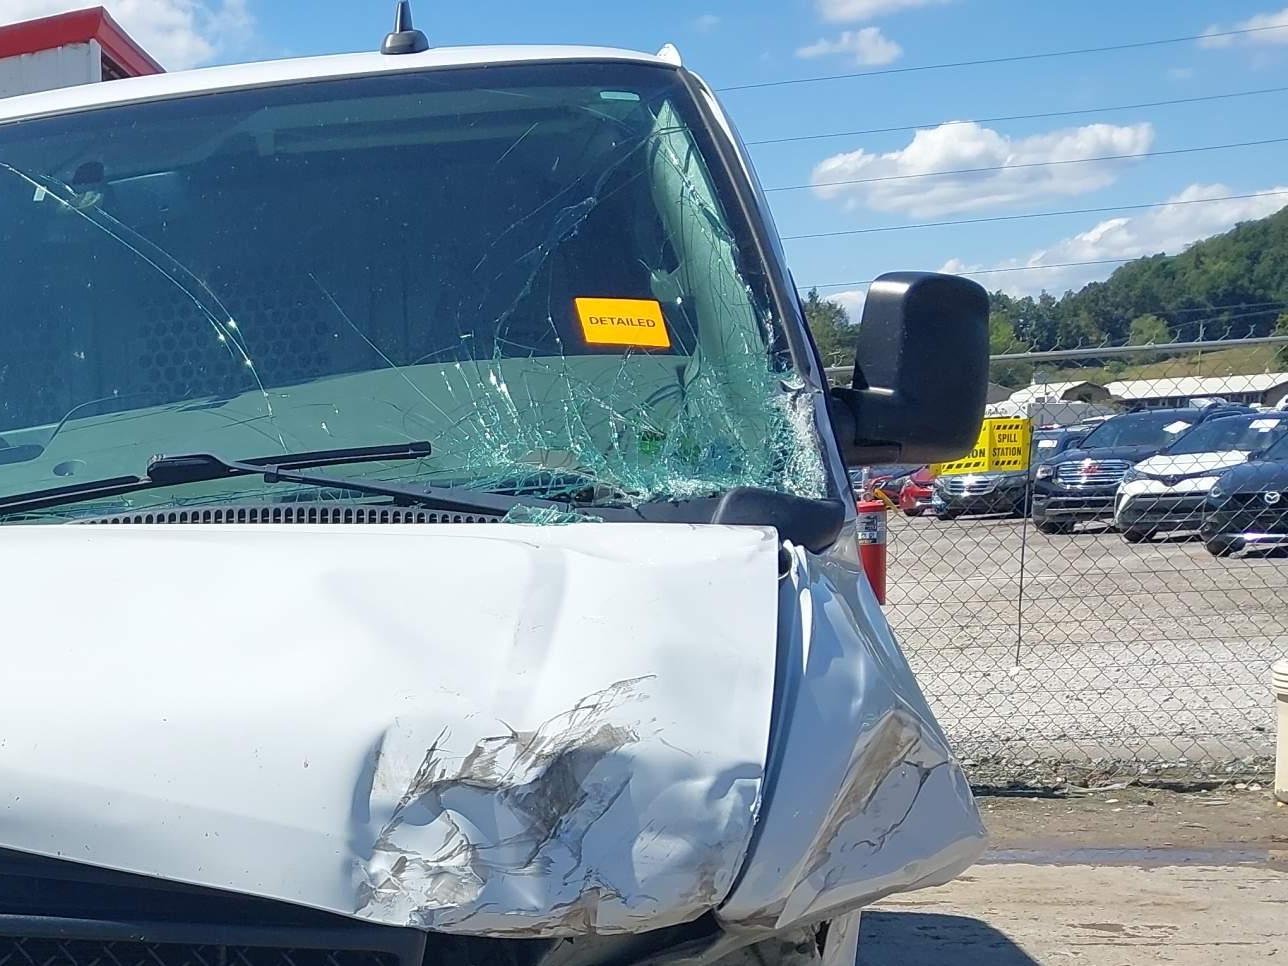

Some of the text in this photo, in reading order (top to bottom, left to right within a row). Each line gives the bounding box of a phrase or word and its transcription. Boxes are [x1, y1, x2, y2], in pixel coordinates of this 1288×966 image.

[588, 316, 656, 328] DETAILED
[997, 433, 1017, 443] SPILL
[992, 447, 1021, 457] STATION
